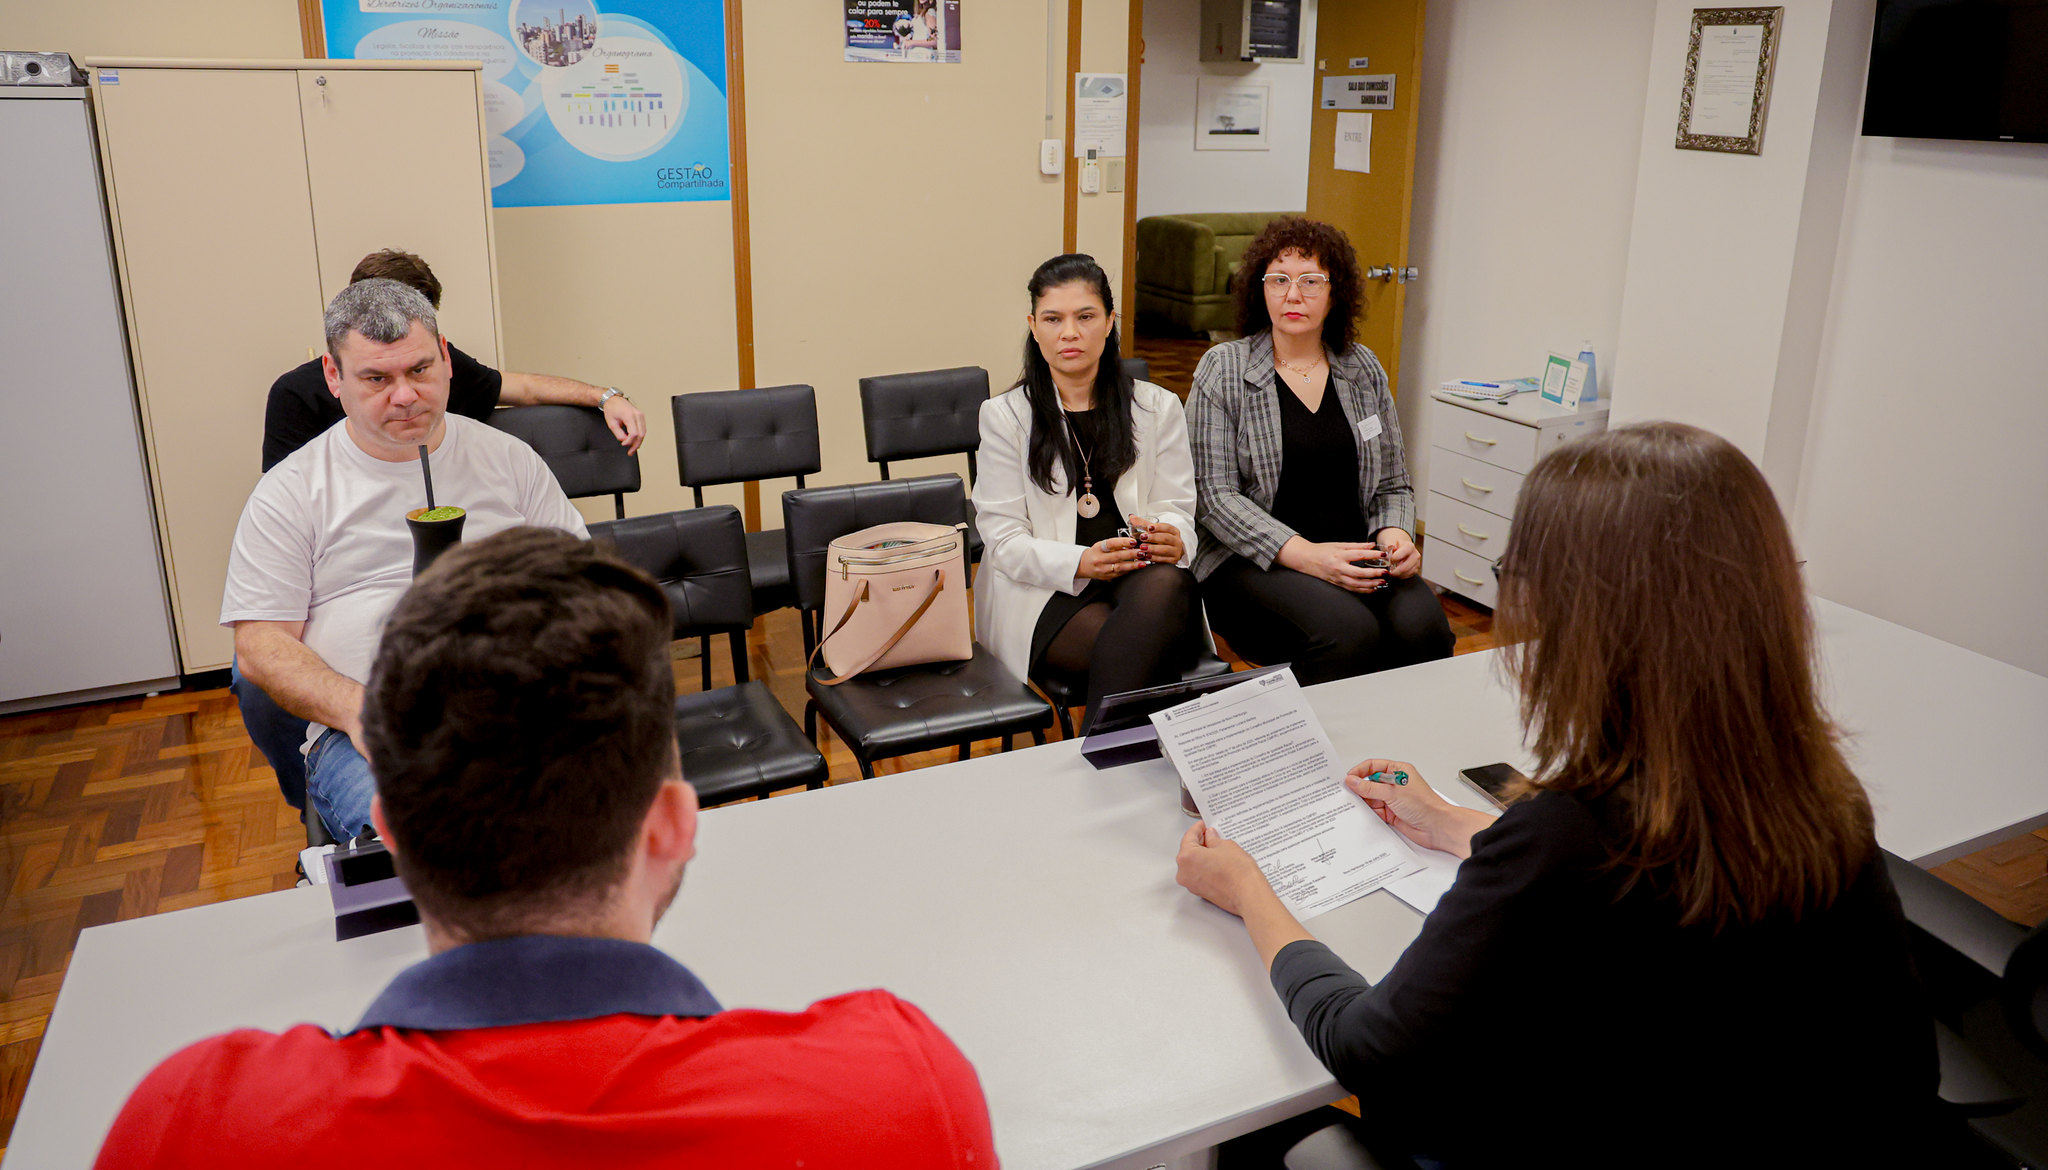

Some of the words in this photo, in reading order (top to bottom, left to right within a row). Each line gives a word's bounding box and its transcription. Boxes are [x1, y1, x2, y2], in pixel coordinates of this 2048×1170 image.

[422, 0, 499, 11] Organizacionais
[868, 0, 891, 8] podem
[848, 7, 866, 15] calar
[885, 9, 908, 17] sempre
[864, 19, 881, 28] 20%
[592, 48, 653, 59] Organograma
[656, 164, 713, 180] GESTÃO
[657, 178, 724, 190] Compartilhada
